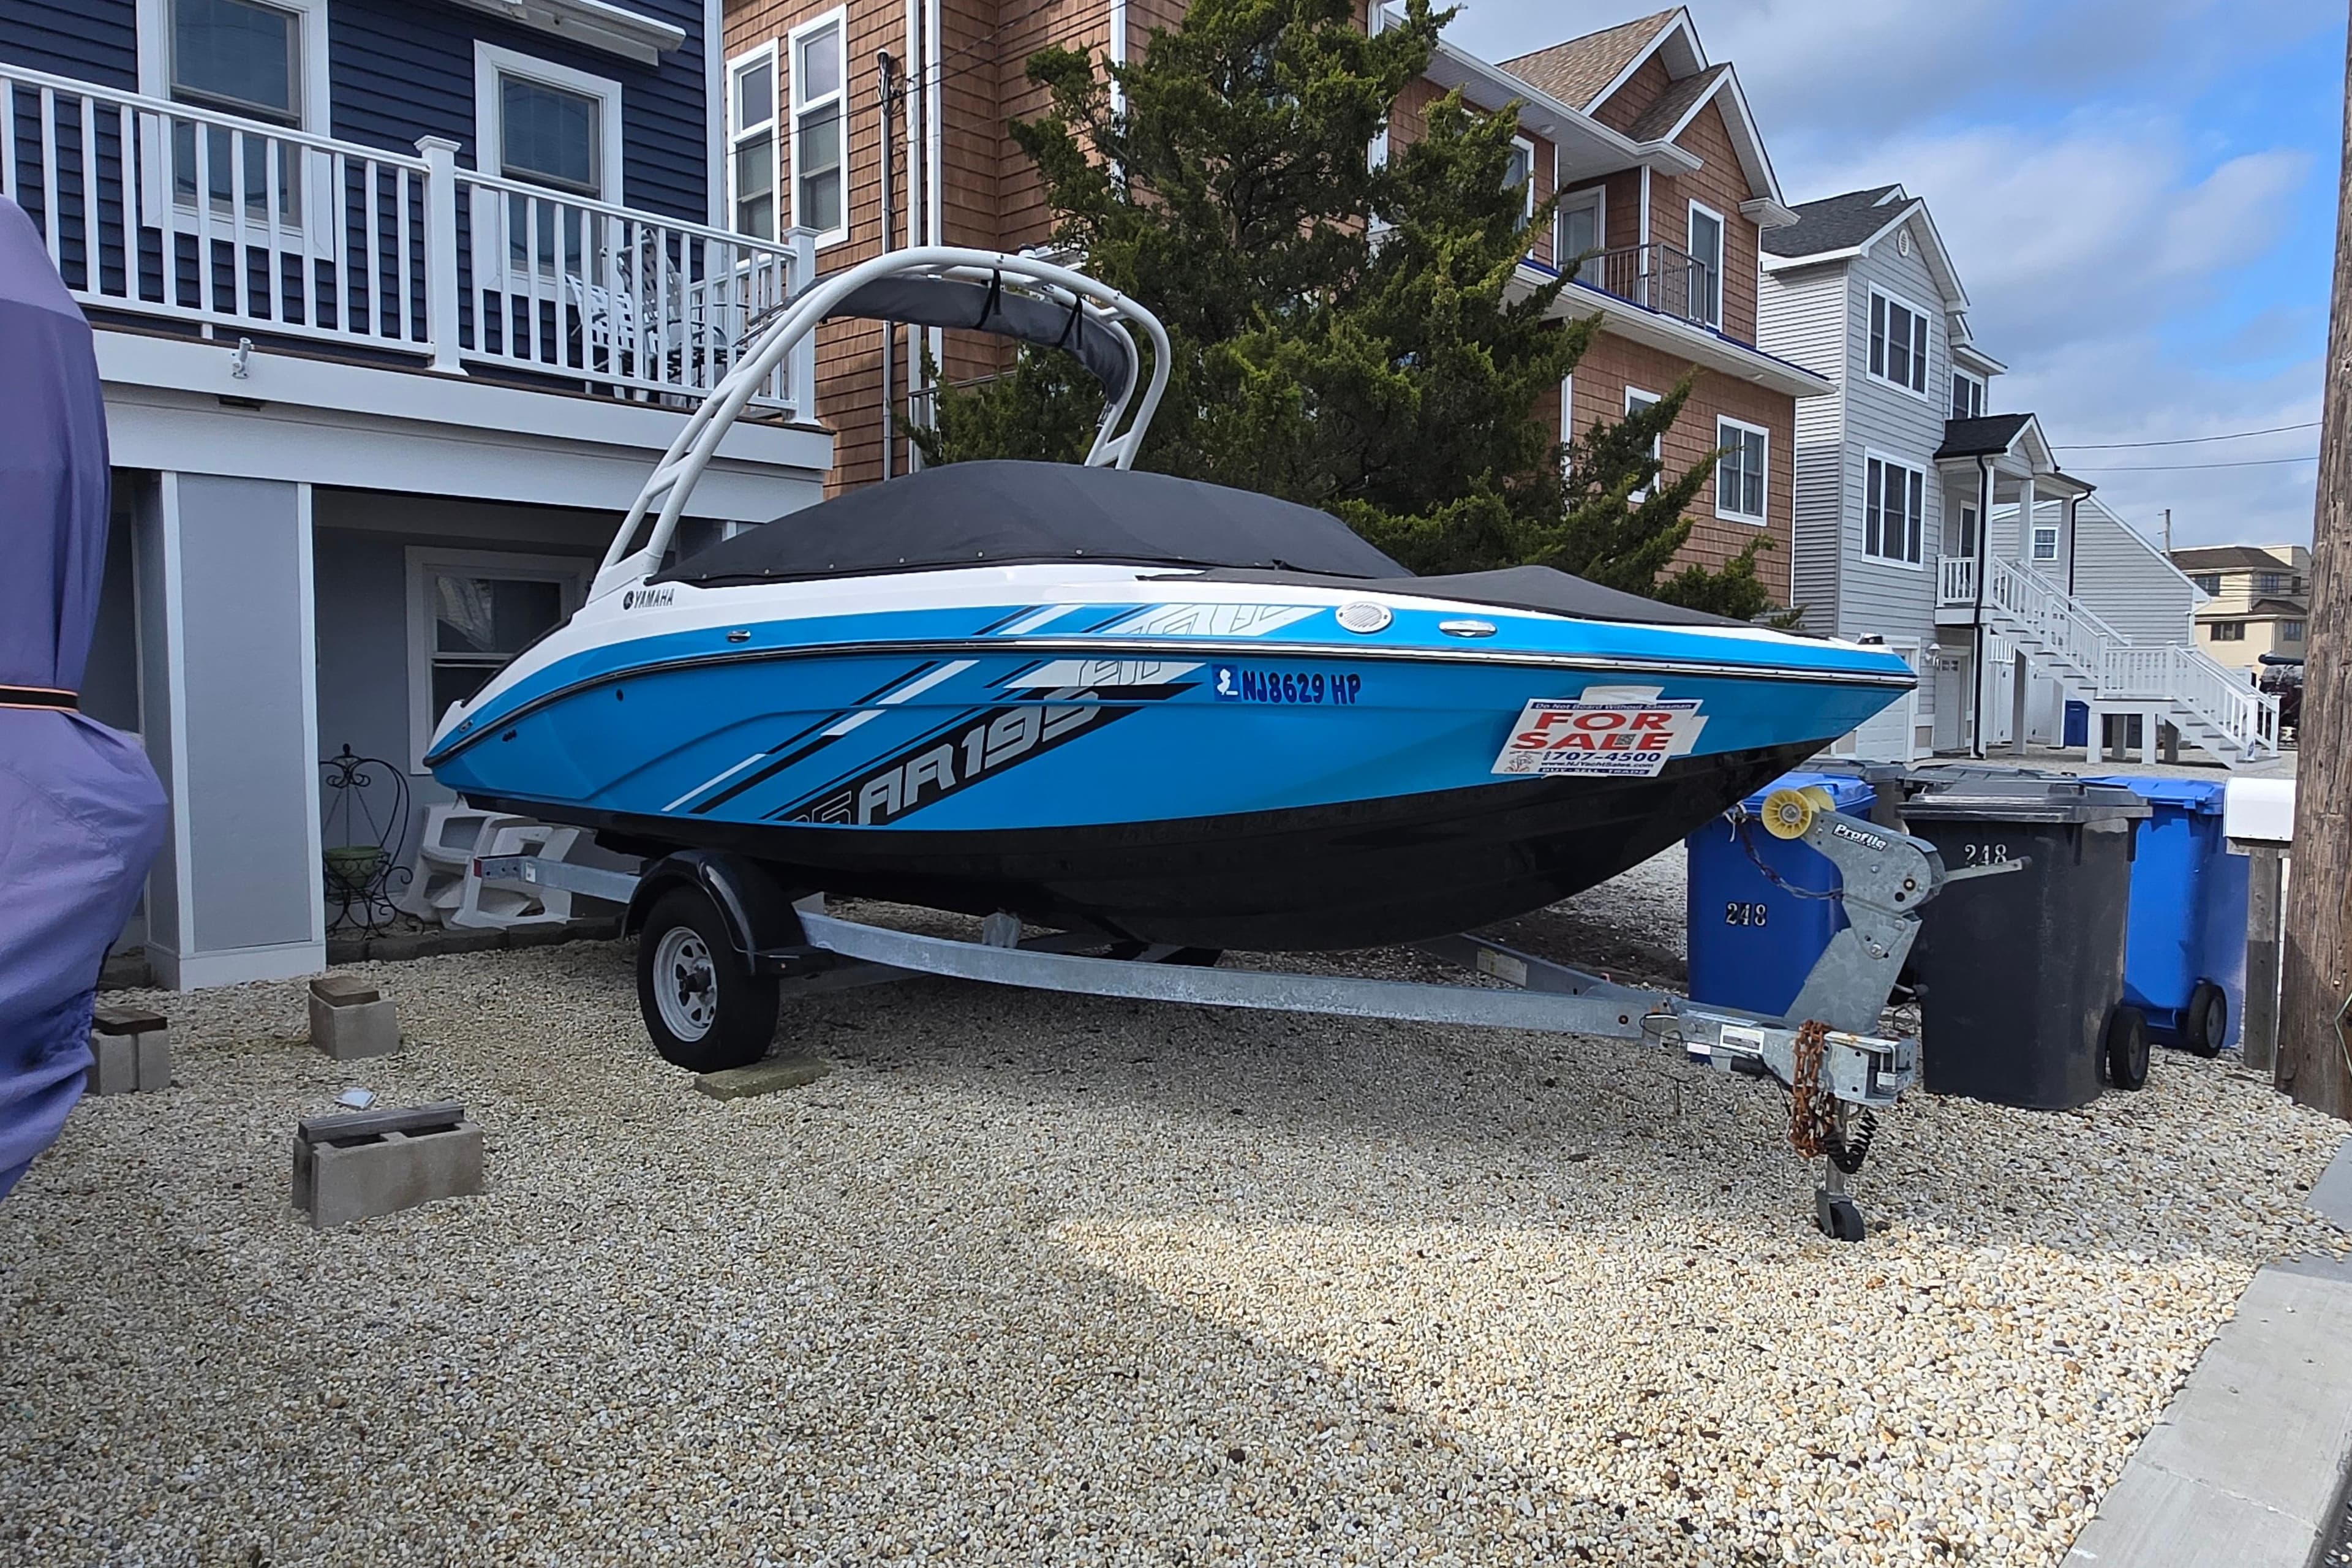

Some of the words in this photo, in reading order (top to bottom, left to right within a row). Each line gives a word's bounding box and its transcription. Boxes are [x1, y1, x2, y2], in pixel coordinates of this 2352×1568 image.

[634, 588, 674, 608] YAMAHA
[1242, 670, 1325, 704] NJ8629
[1331, 674, 1361, 704] HP
[1534, 712, 1672, 731] FOR
[1510, 732, 1673, 750] SALE
[858, 687, 1101, 825] AR195
[1553, 752, 1661, 762] 707-4500
[1834, 824, 1887, 848] Profile
[1965, 845, 2007, 867] 248
[1726, 903, 1765, 925] 248
